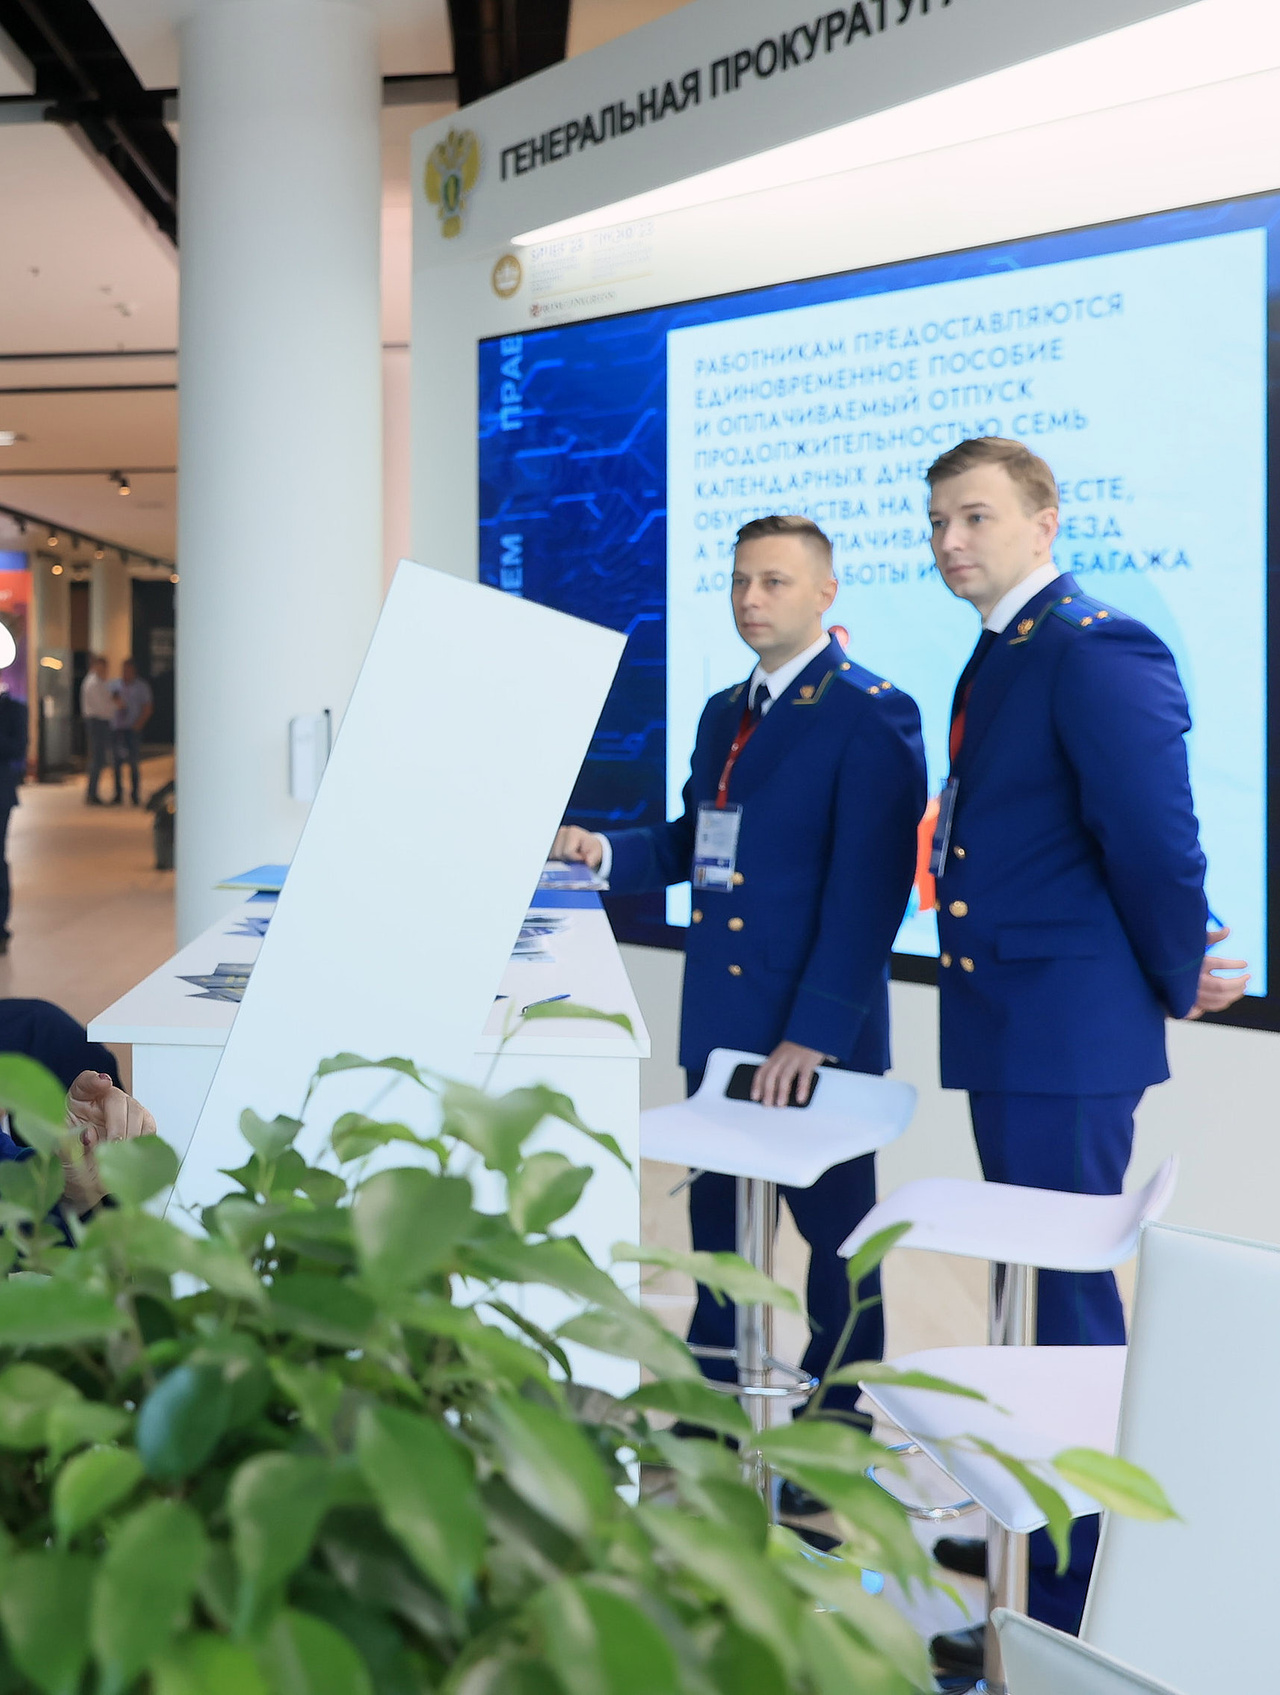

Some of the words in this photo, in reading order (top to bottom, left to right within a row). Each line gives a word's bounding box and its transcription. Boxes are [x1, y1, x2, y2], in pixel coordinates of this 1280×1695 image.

[500, 69, 700, 181] ГЕНЕРАЛЬНАЯ
[709, 0, 956, 98] ПРОКУРАТУ
[694, 336, 846, 378] РАБОТНИКАМ
[854, 292, 1125, 351] ПРЕДОСТАВЛЯЮТСЯ
[694, 359, 920, 410] ЕДИНОВРЕМЕННОЕ
[928, 337, 1063, 378] ПОСОБИЕ
[694, 419, 712, 439] И
[718, 387, 920, 437] ОПЛАЧИВАЕМЫЙ
[928, 376, 1035, 412] ОТПУСК
[694, 416, 1003, 471] ПРОДОЛЖИТЕЛЬНОСТЬЮ
[1011, 408, 1089, 438] СЕМЬ
[694, 469, 869, 501] КАЛЕНДАРНЫХ
[877, 459, 936, 487] ДНЕ
[878, 496, 915, 516] НА
[1057, 477, 1135, 505] ЕСТЕ,
[498, 532, 525, 599] ЕМ
[694, 571, 729, 593] ДО
[837, 562, 910, 586] БОТЫ
[1070, 549, 1192, 576] БАГАЖА
